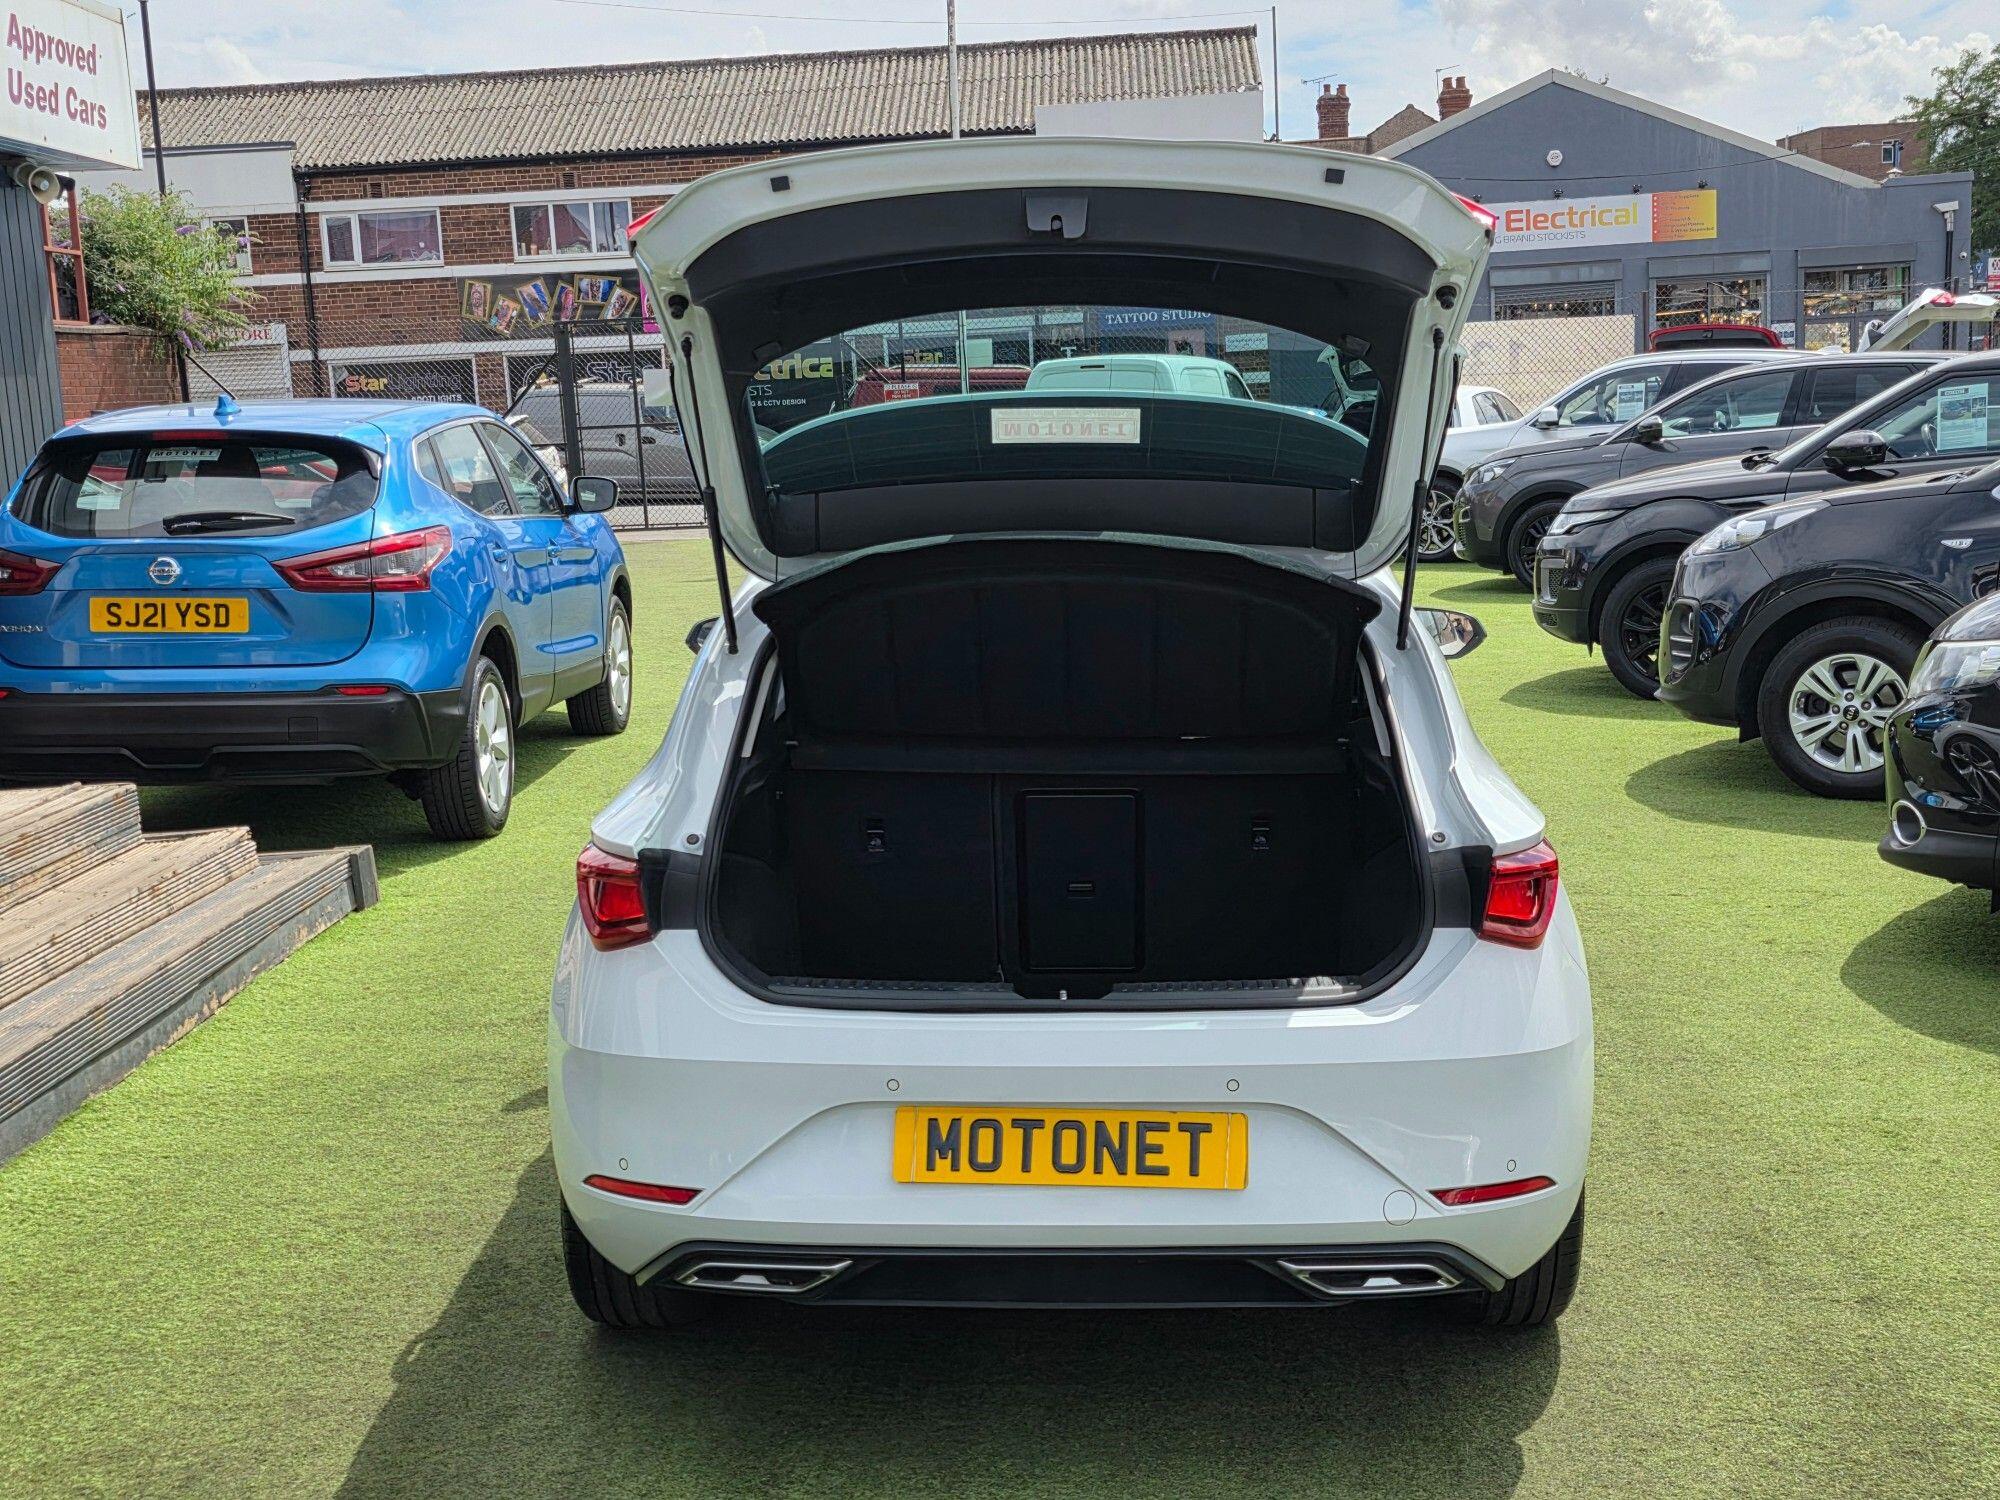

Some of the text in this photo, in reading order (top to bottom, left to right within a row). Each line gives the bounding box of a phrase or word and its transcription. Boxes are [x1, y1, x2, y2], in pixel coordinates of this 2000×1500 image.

[7, 13, 97, 76] Approved
[8, 67, 107, 130] Used Cars
[1505, 202, 1638, 233] Electrical
[1503, 234, 1535, 244] BRAND
[1536, 230, 1586, 242] STOCKISTS
[1105, 311, 1158, 325] TATTOO
[345, 374, 387, 392] Star
[587, 361, 655, 384] Sta
[782, 398, 808, 406] DESIGN
[106, 603, 230, 628] SJ21 YSD
[926, 1118, 1212, 1176] MOTONET
